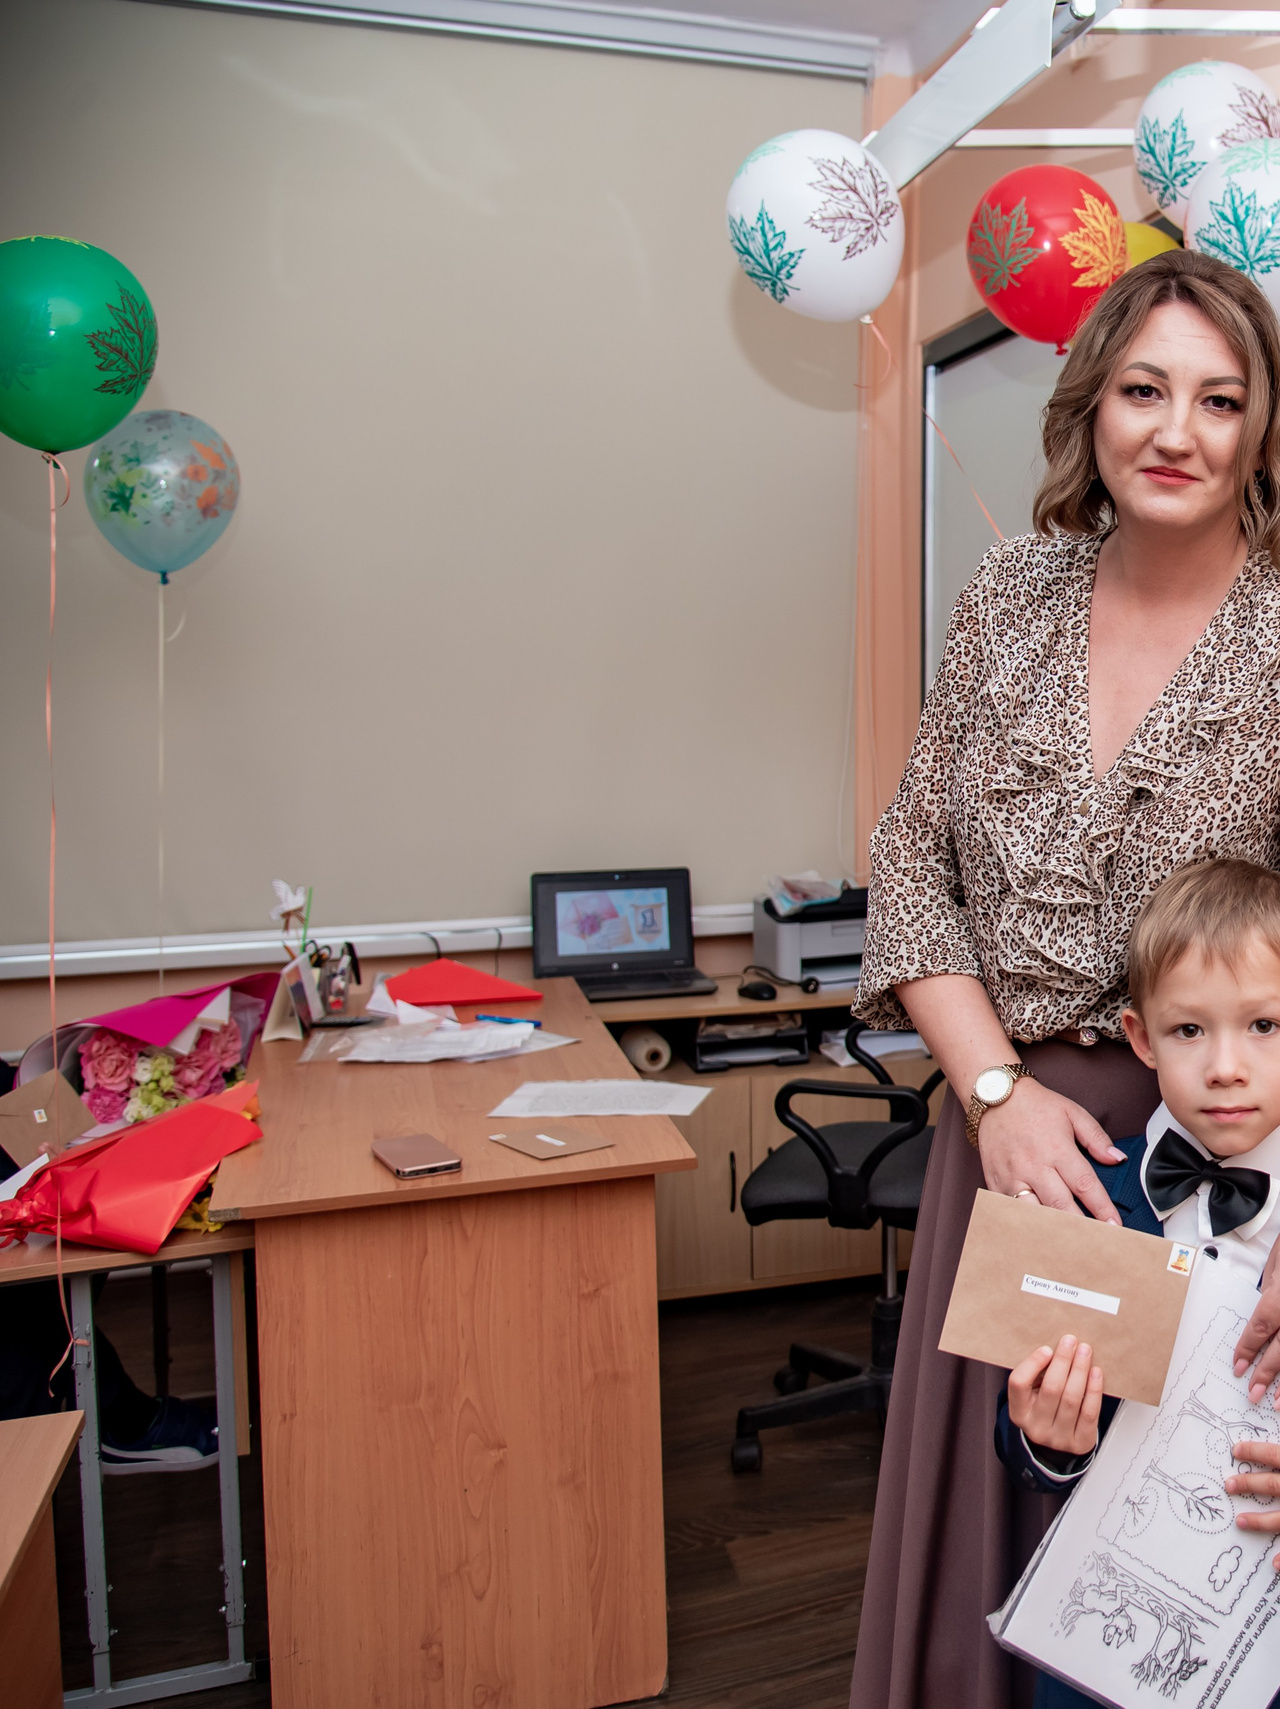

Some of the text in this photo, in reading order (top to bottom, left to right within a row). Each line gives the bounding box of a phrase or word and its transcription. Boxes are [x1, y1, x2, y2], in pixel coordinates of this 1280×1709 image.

[1053, 1284, 1080, 1297] Антону
[1254, 1596, 1269, 1613] Кто
[1243, 1613, 1257, 1630] где
[1253, 1606, 1278, 1639] Помоги
[1226, 1629, 1246, 1660] может
[1229, 1638, 1255, 1678] друзьям
